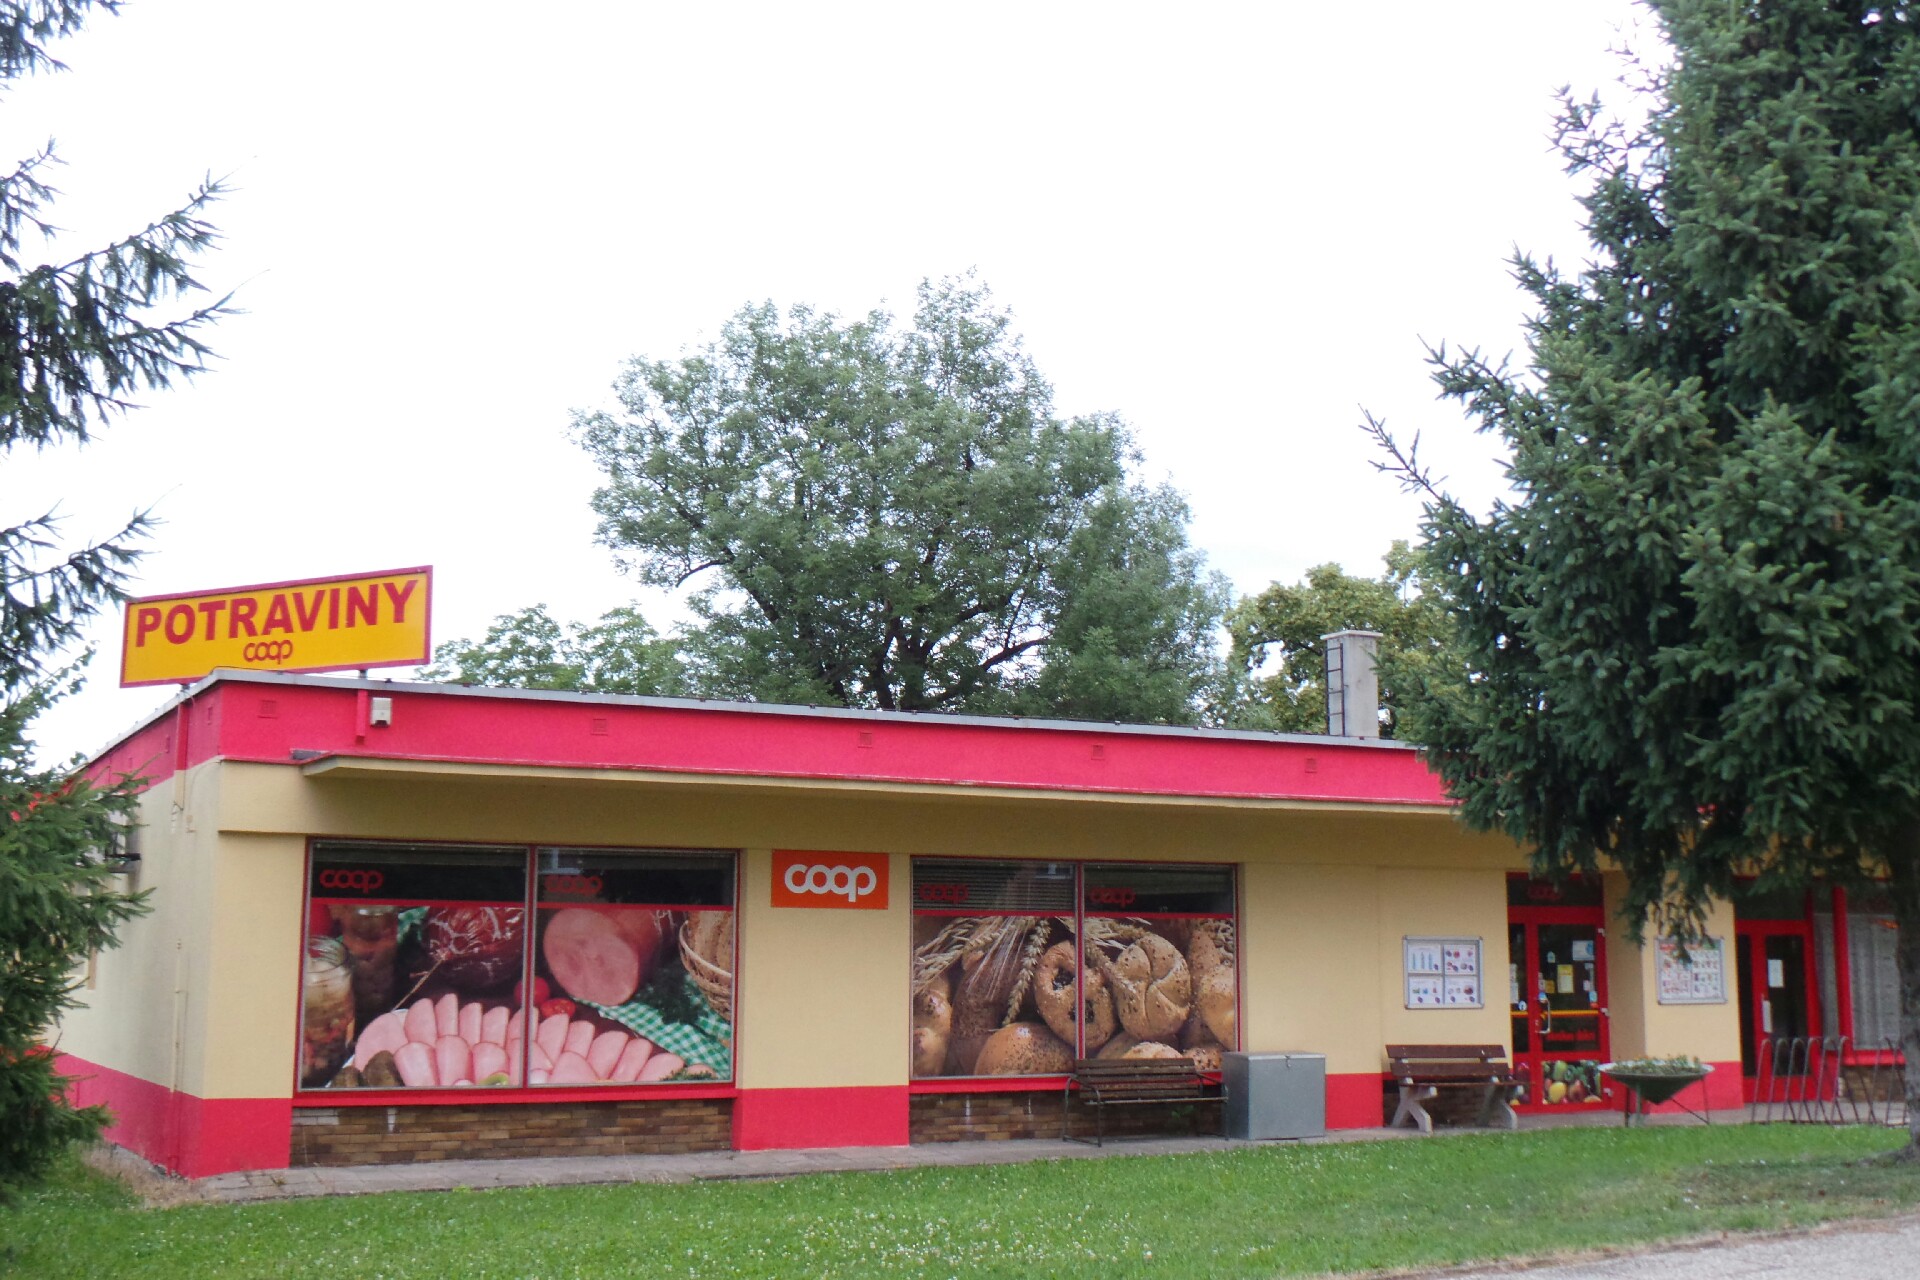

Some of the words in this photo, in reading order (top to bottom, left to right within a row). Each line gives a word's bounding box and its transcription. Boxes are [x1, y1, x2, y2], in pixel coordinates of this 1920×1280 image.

[136, 580, 418, 648] POTRAVINY
[243, 639, 293, 665] coop
[320, 869, 384, 893] coop
[784, 864, 877, 902] coop
[918, 883, 968, 905] coop
[1089, 887, 1136, 908] coop
